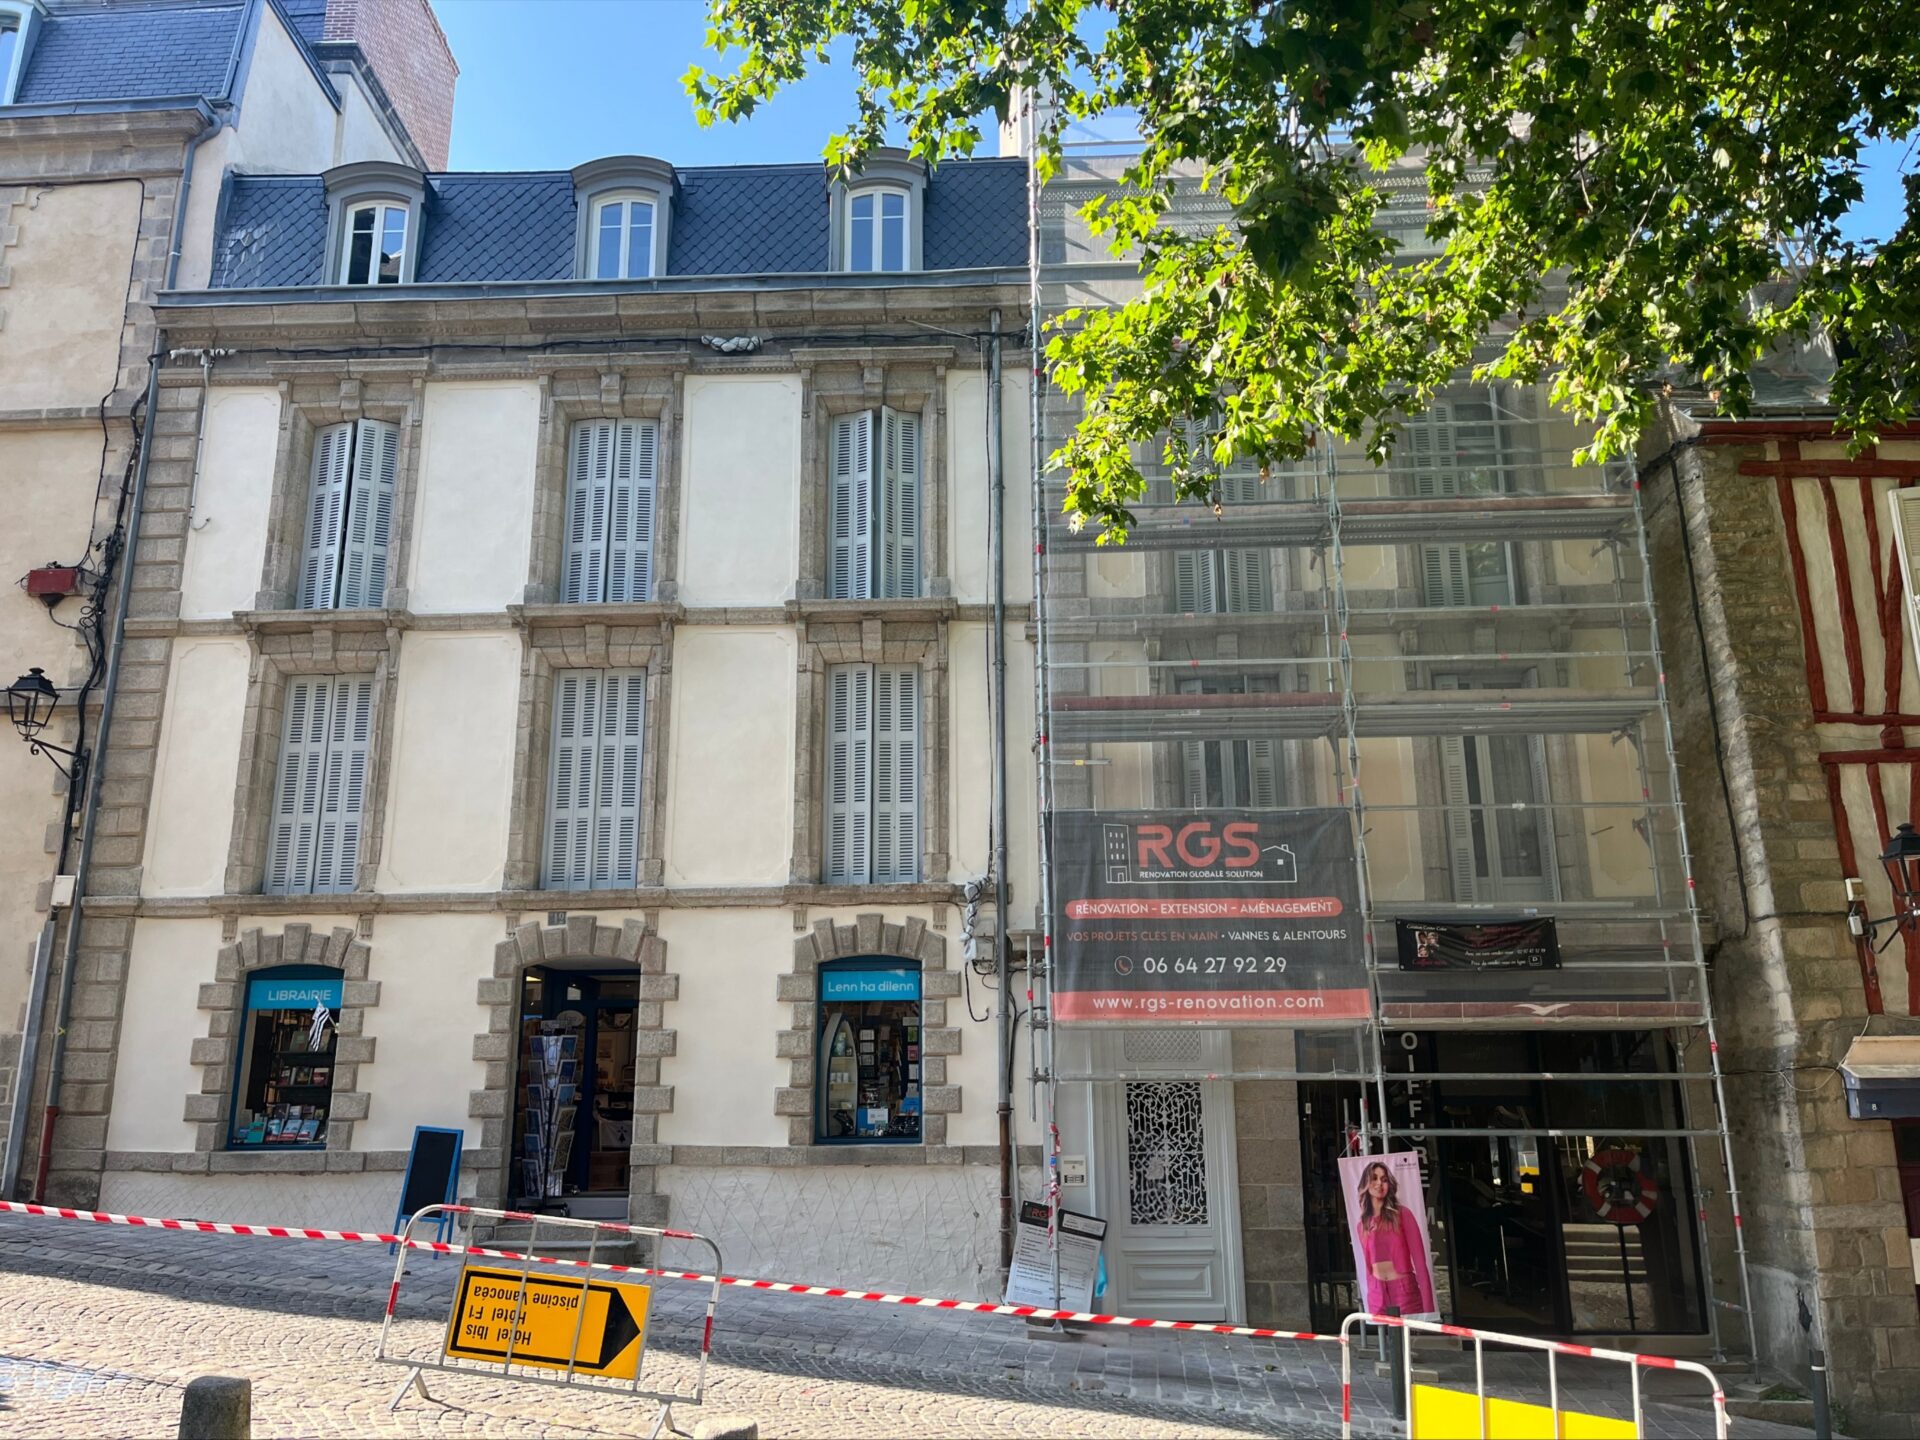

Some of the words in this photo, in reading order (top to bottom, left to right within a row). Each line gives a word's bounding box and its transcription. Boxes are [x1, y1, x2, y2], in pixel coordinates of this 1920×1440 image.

[1136, 822, 1260, 868] RGS
[1139, 871, 1188, 879] RENOVATION
[1189, 870, 1224, 878] GLOBALE
[1225, 870, 1264, 878] SOLUTION
[1075, 902, 1149, 915] RÉNOVATION
[1160, 903, 1228, 914] EXTENSION
[1240, 900, 1333, 914] AMÉNAGEMENT
[1066, 931, 1089, 942] VOS
[1091, 931, 1138, 942] PROJETS
[1170, 931, 1185, 941] EN
[1188, 930, 1218, 941] MAIN
[1228, 930, 1270, 941] VANNES
[1272, 931, 1281, 941] &
[1283, 929, 1347, 941] ALENTOURS
[1143, 957, 1168, 974] 06
[1174, 957, 1198, 974] 64
[1204, 956, 1226, 974] 27
[1233, 956, 1258, 973] 92
[1263, 956, 1287, 973] 29
[828, 981, 858, 993] Lenn
[860, 980, 876, 992] ha
[878, 980, 914, 992] dilenn
[268, 989, 332, 1001] LIBRAIRIE
[1092, 994, 1324, 1013] www.rgs-renovation.com
[532, 1291, 579, 1311] piscine
[468, 1304, 484, 1319] F1
[465, 1323, 489, 1341] Ibis
